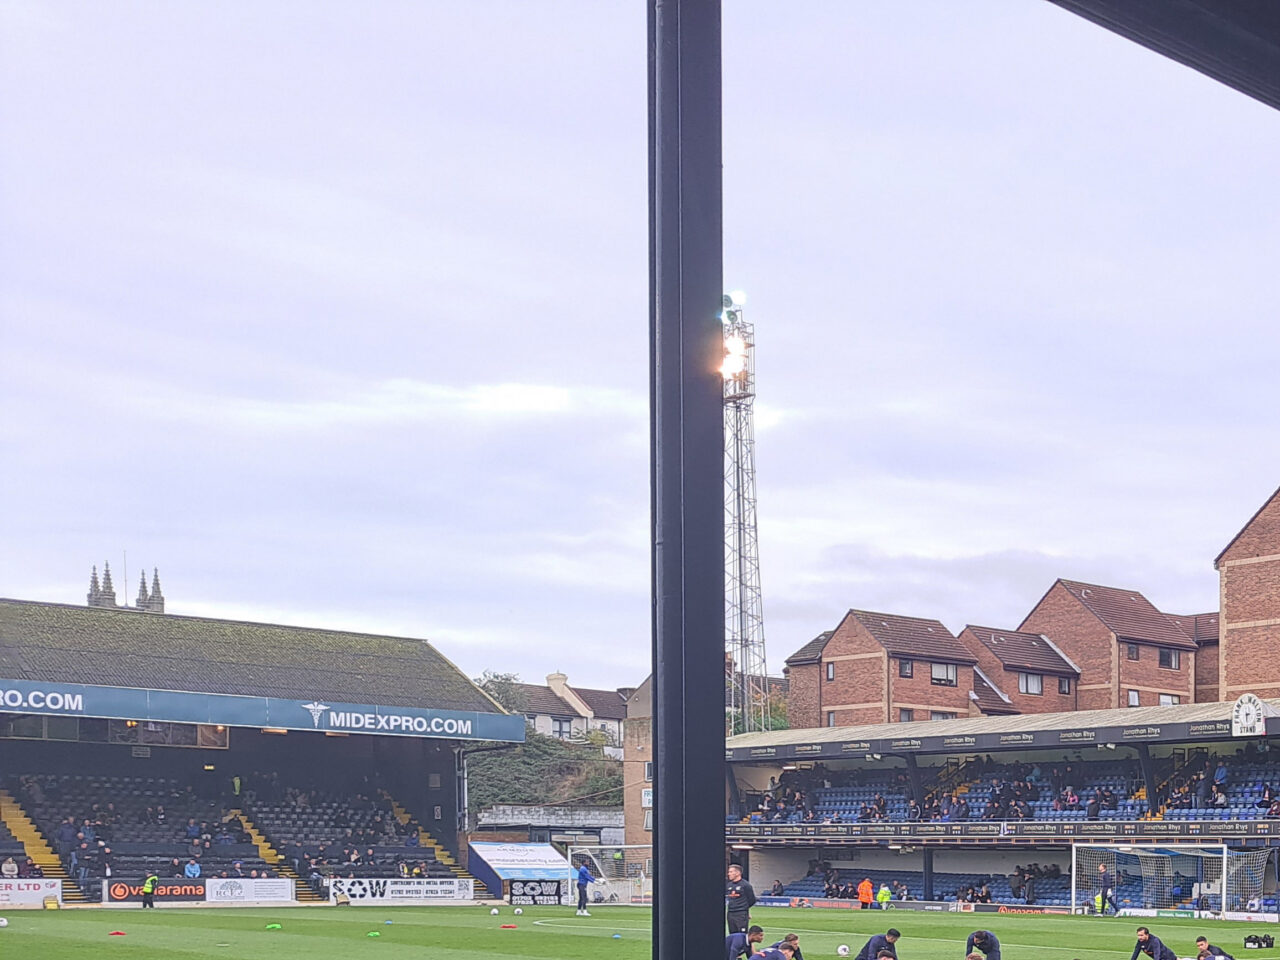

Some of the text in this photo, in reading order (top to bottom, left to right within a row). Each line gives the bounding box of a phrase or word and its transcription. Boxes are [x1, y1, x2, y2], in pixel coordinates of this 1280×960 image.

[330, 711, 472, 735] MIDEXPRO.COM
[1240, 726, 1256, 734] STAND
[130, 885, 204, 895] vaarama
